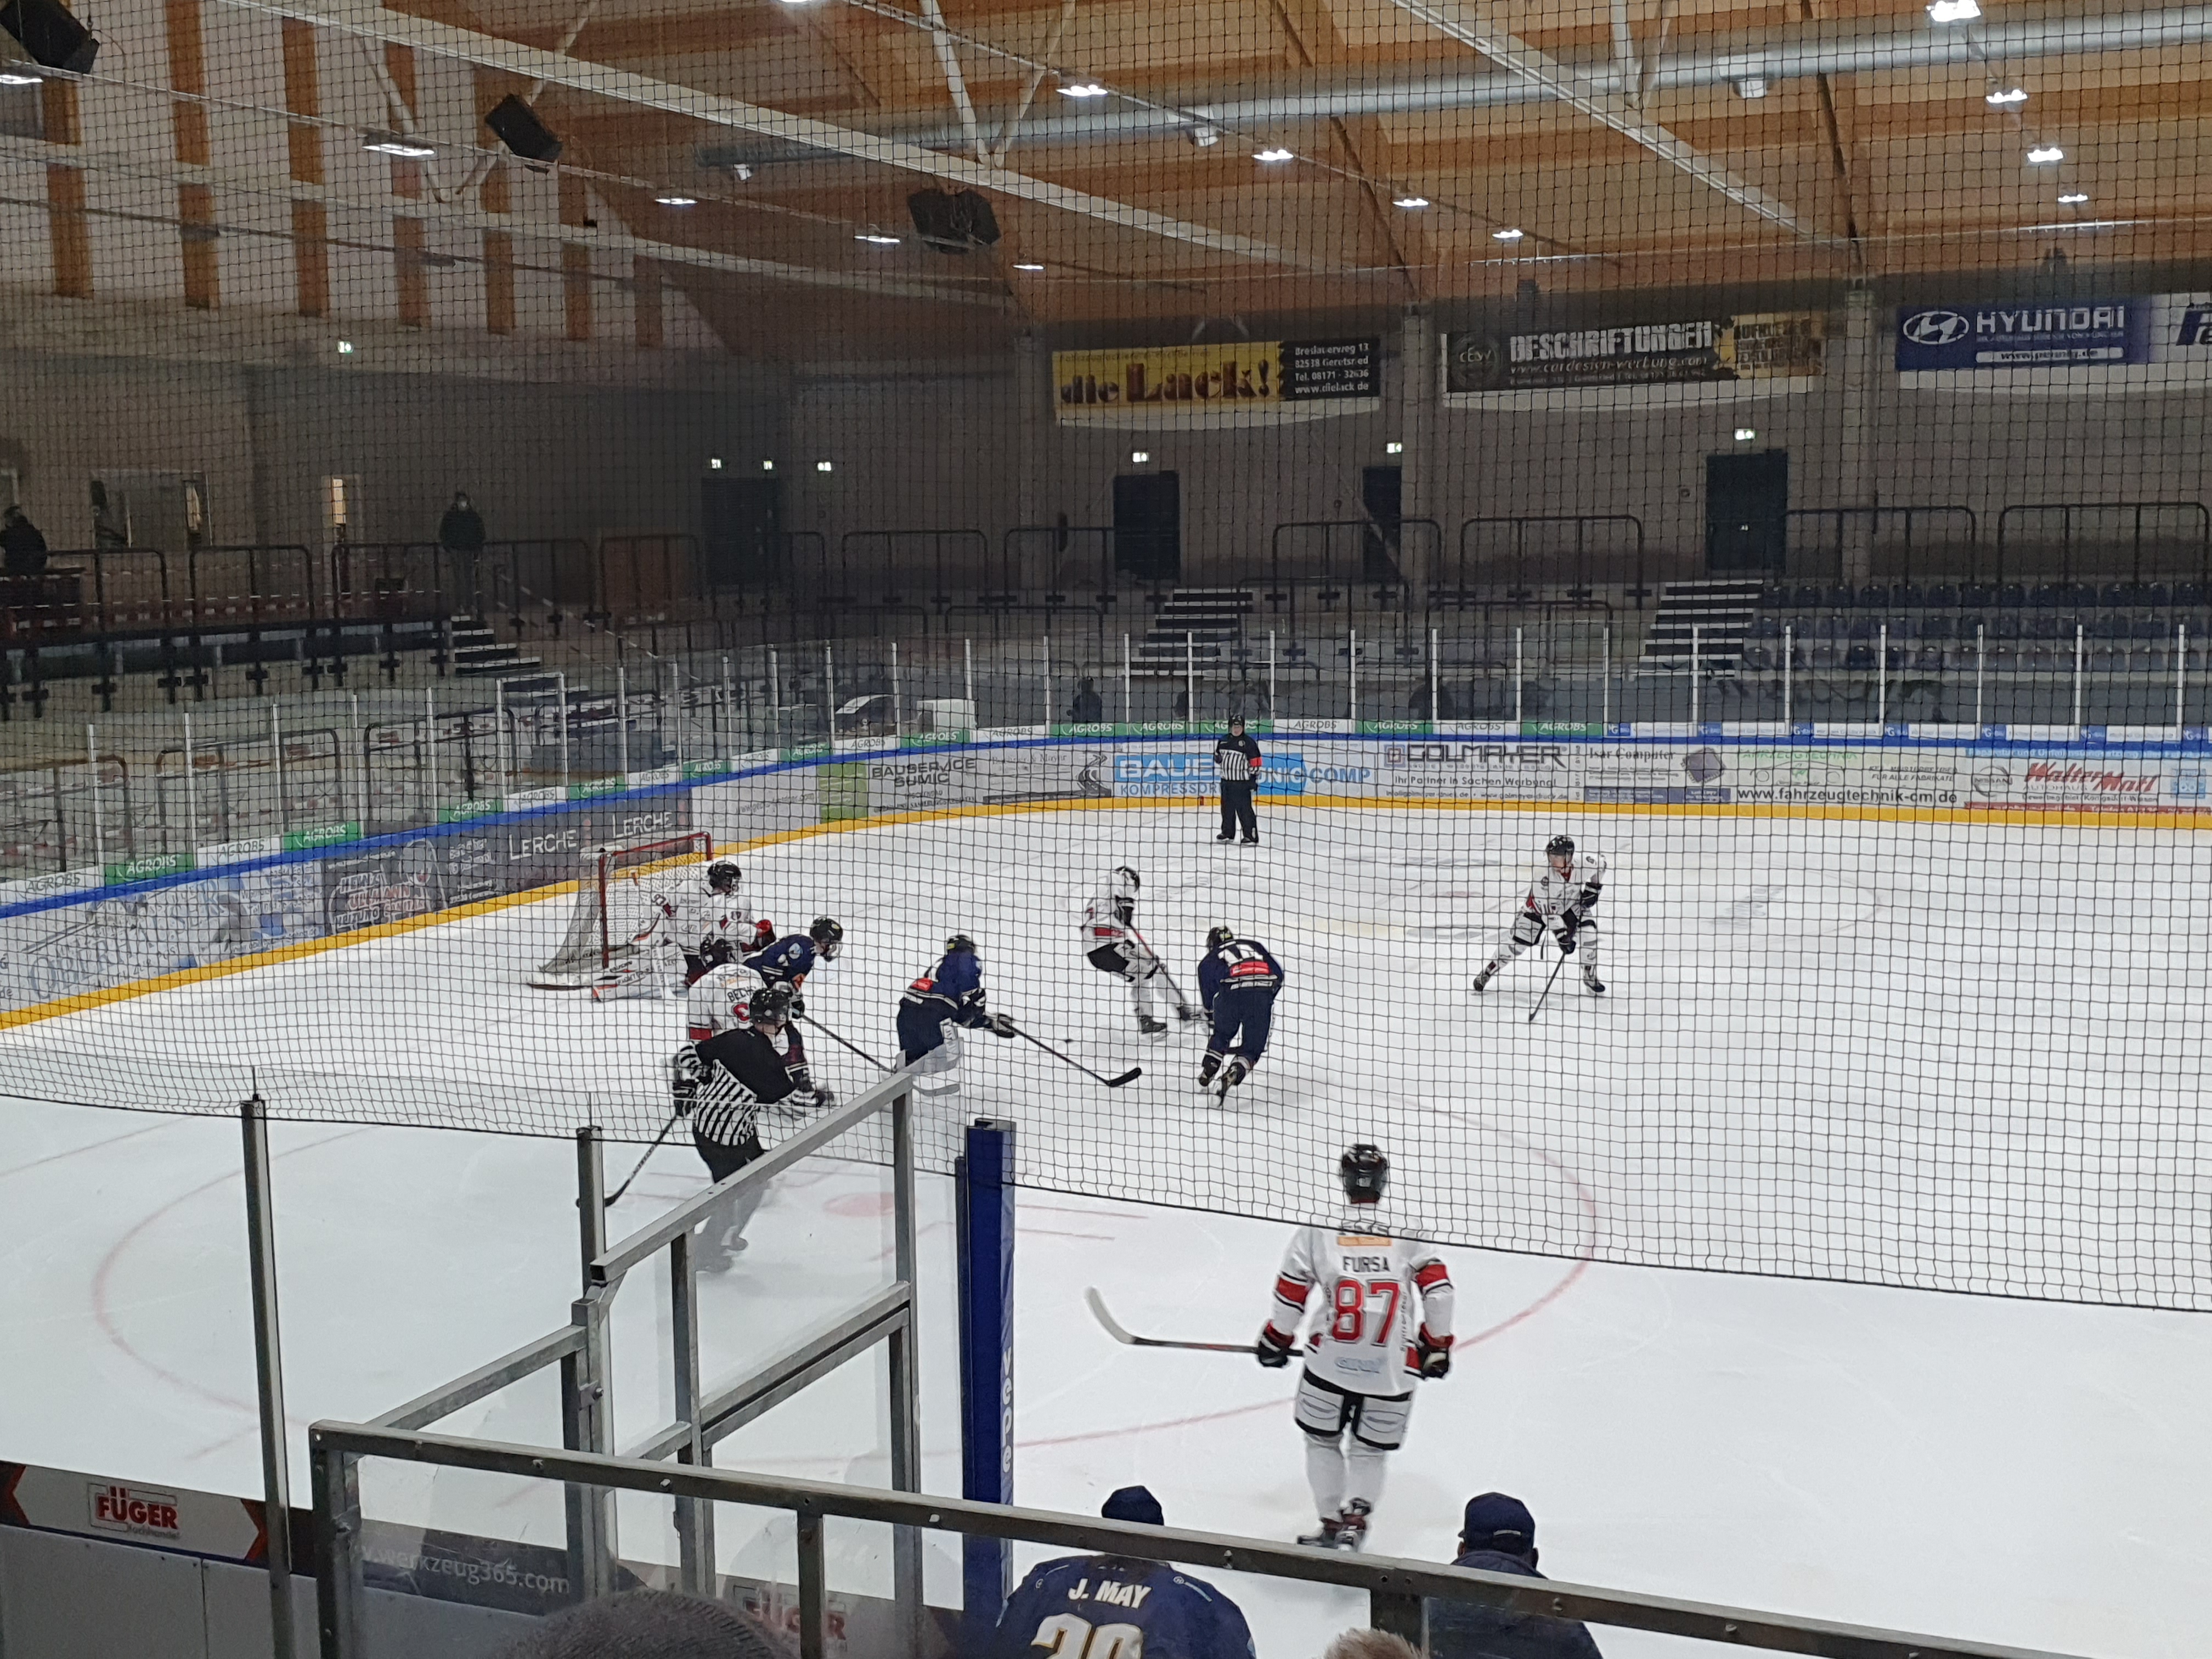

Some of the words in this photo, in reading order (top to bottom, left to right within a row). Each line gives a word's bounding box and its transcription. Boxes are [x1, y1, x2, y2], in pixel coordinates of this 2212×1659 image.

[1977, 306, 2125, 333] HYUNDAI
[1358, 343, 1369, 352] 13
[1510, 321, 1712, 363] BESCHRIFTUNGEN
[1295, 359, 1320, 368] 82538
[1322, 356, 1369, 366] Geretsred
[1061, 374, 1119, 404] die
[1126, 359, 1269, 402] Lack!
[1295, 372, 1310, 381] Tel.
[1312, 371, 1335, 380] 08171
[1070, 723, 1113, 733] AGROBS
[1294, 720, 1337, 729] AGROBS
[1540, 722, 1586, 731] AGROBS
[1590, 747, 1611, 759] Isar
[1616, 747, 1676, 763] Computer
[872, 758, 976, 779] BAUSERVICE
[1120, 759, 1220, 778] BAUE
[2024, 761, 2104, 783] Walter
[895, 773, 949, 788] SUMIC
[1395, 776, 1407, 785] Ihr
[1410, 777, 1446, 785] Partner
[1462, 776, 1502, 786] Sachen
[613, 811, 673, 839] LERCHE
[217, 838, 265, 857] AGROBS
[509, 829, 577, 860] LERCHE
[1342, 1255, 1391, 1273] FURSA
[1331, 1276, 1401, 1347] 87
[97, 1486, 178, 1530] FÜGER
[1068, 1578, 1090, 1600] J.
[1093, 1580, 1152, 1609] MAY
